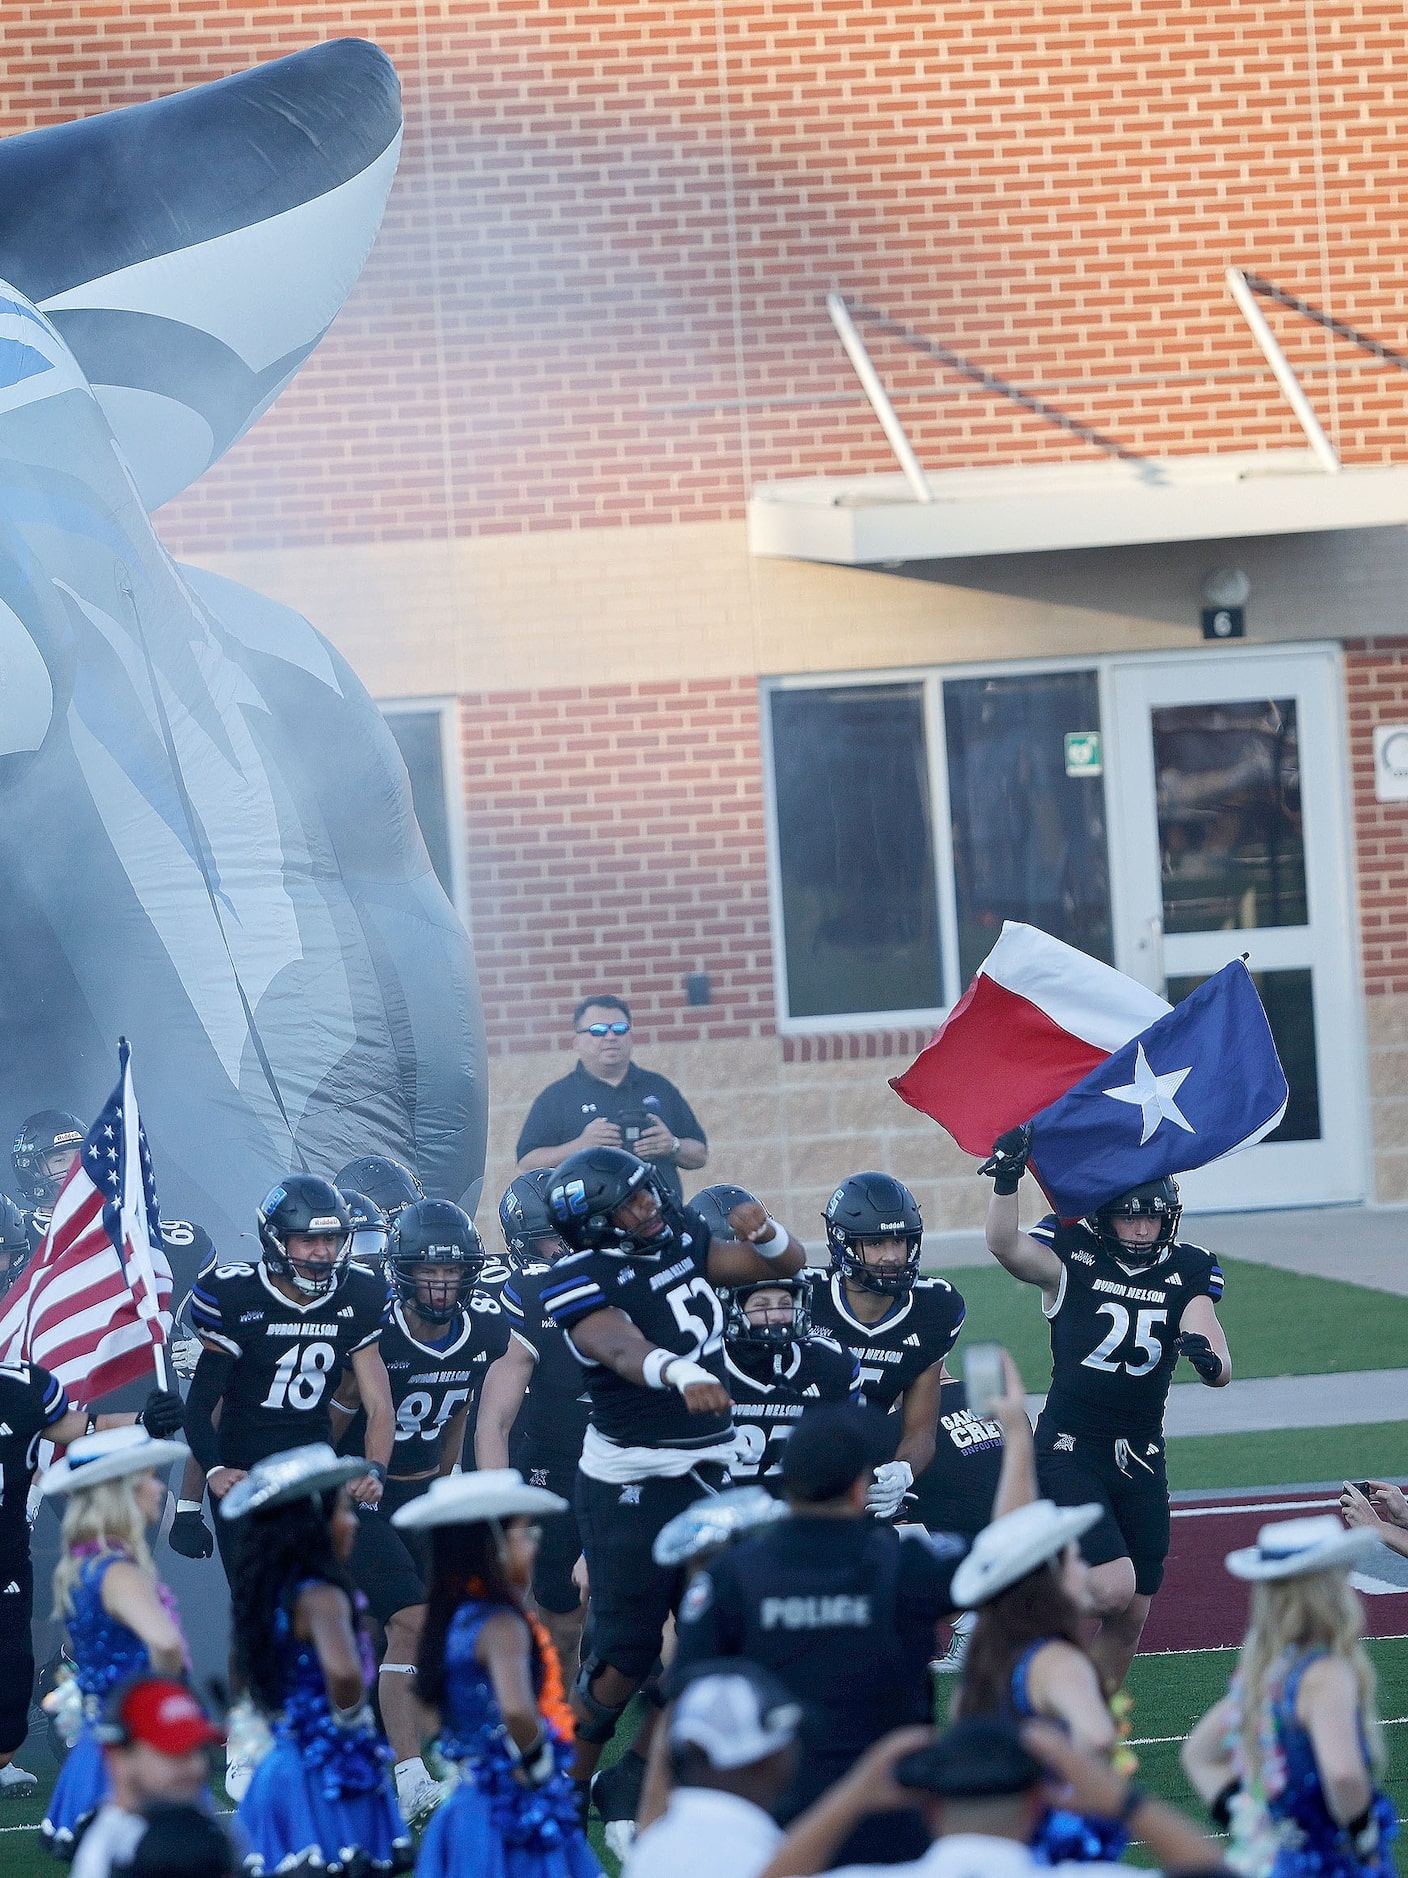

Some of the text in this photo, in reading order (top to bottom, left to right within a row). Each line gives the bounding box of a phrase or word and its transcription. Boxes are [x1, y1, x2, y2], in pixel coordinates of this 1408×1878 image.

[1213, 611, 1232, 637] 6
[550, 1179, 589, 1220] 52
[880, 1221, 905, 1230] Riddell
[1092, 1278, 1166, 1304] BYRON NELSON
[266, 1323, 338, 1337] BYRON NELSON
[666, 1277, 724, 1362] 52
[1080, 1302, 1168, 1376] 25
[866, 1348, 903, 1364] NELSON
[260, 1342, 335, 1410] 18
[438, 1371, 471, 1382] NELSON
[394, 1388, 470, 1441] 85
[764, 1404, 804, 1417] NELSON
[940, 1408, 979, 1430] GAM
[761, 1596, 869, 1630] POLICE
